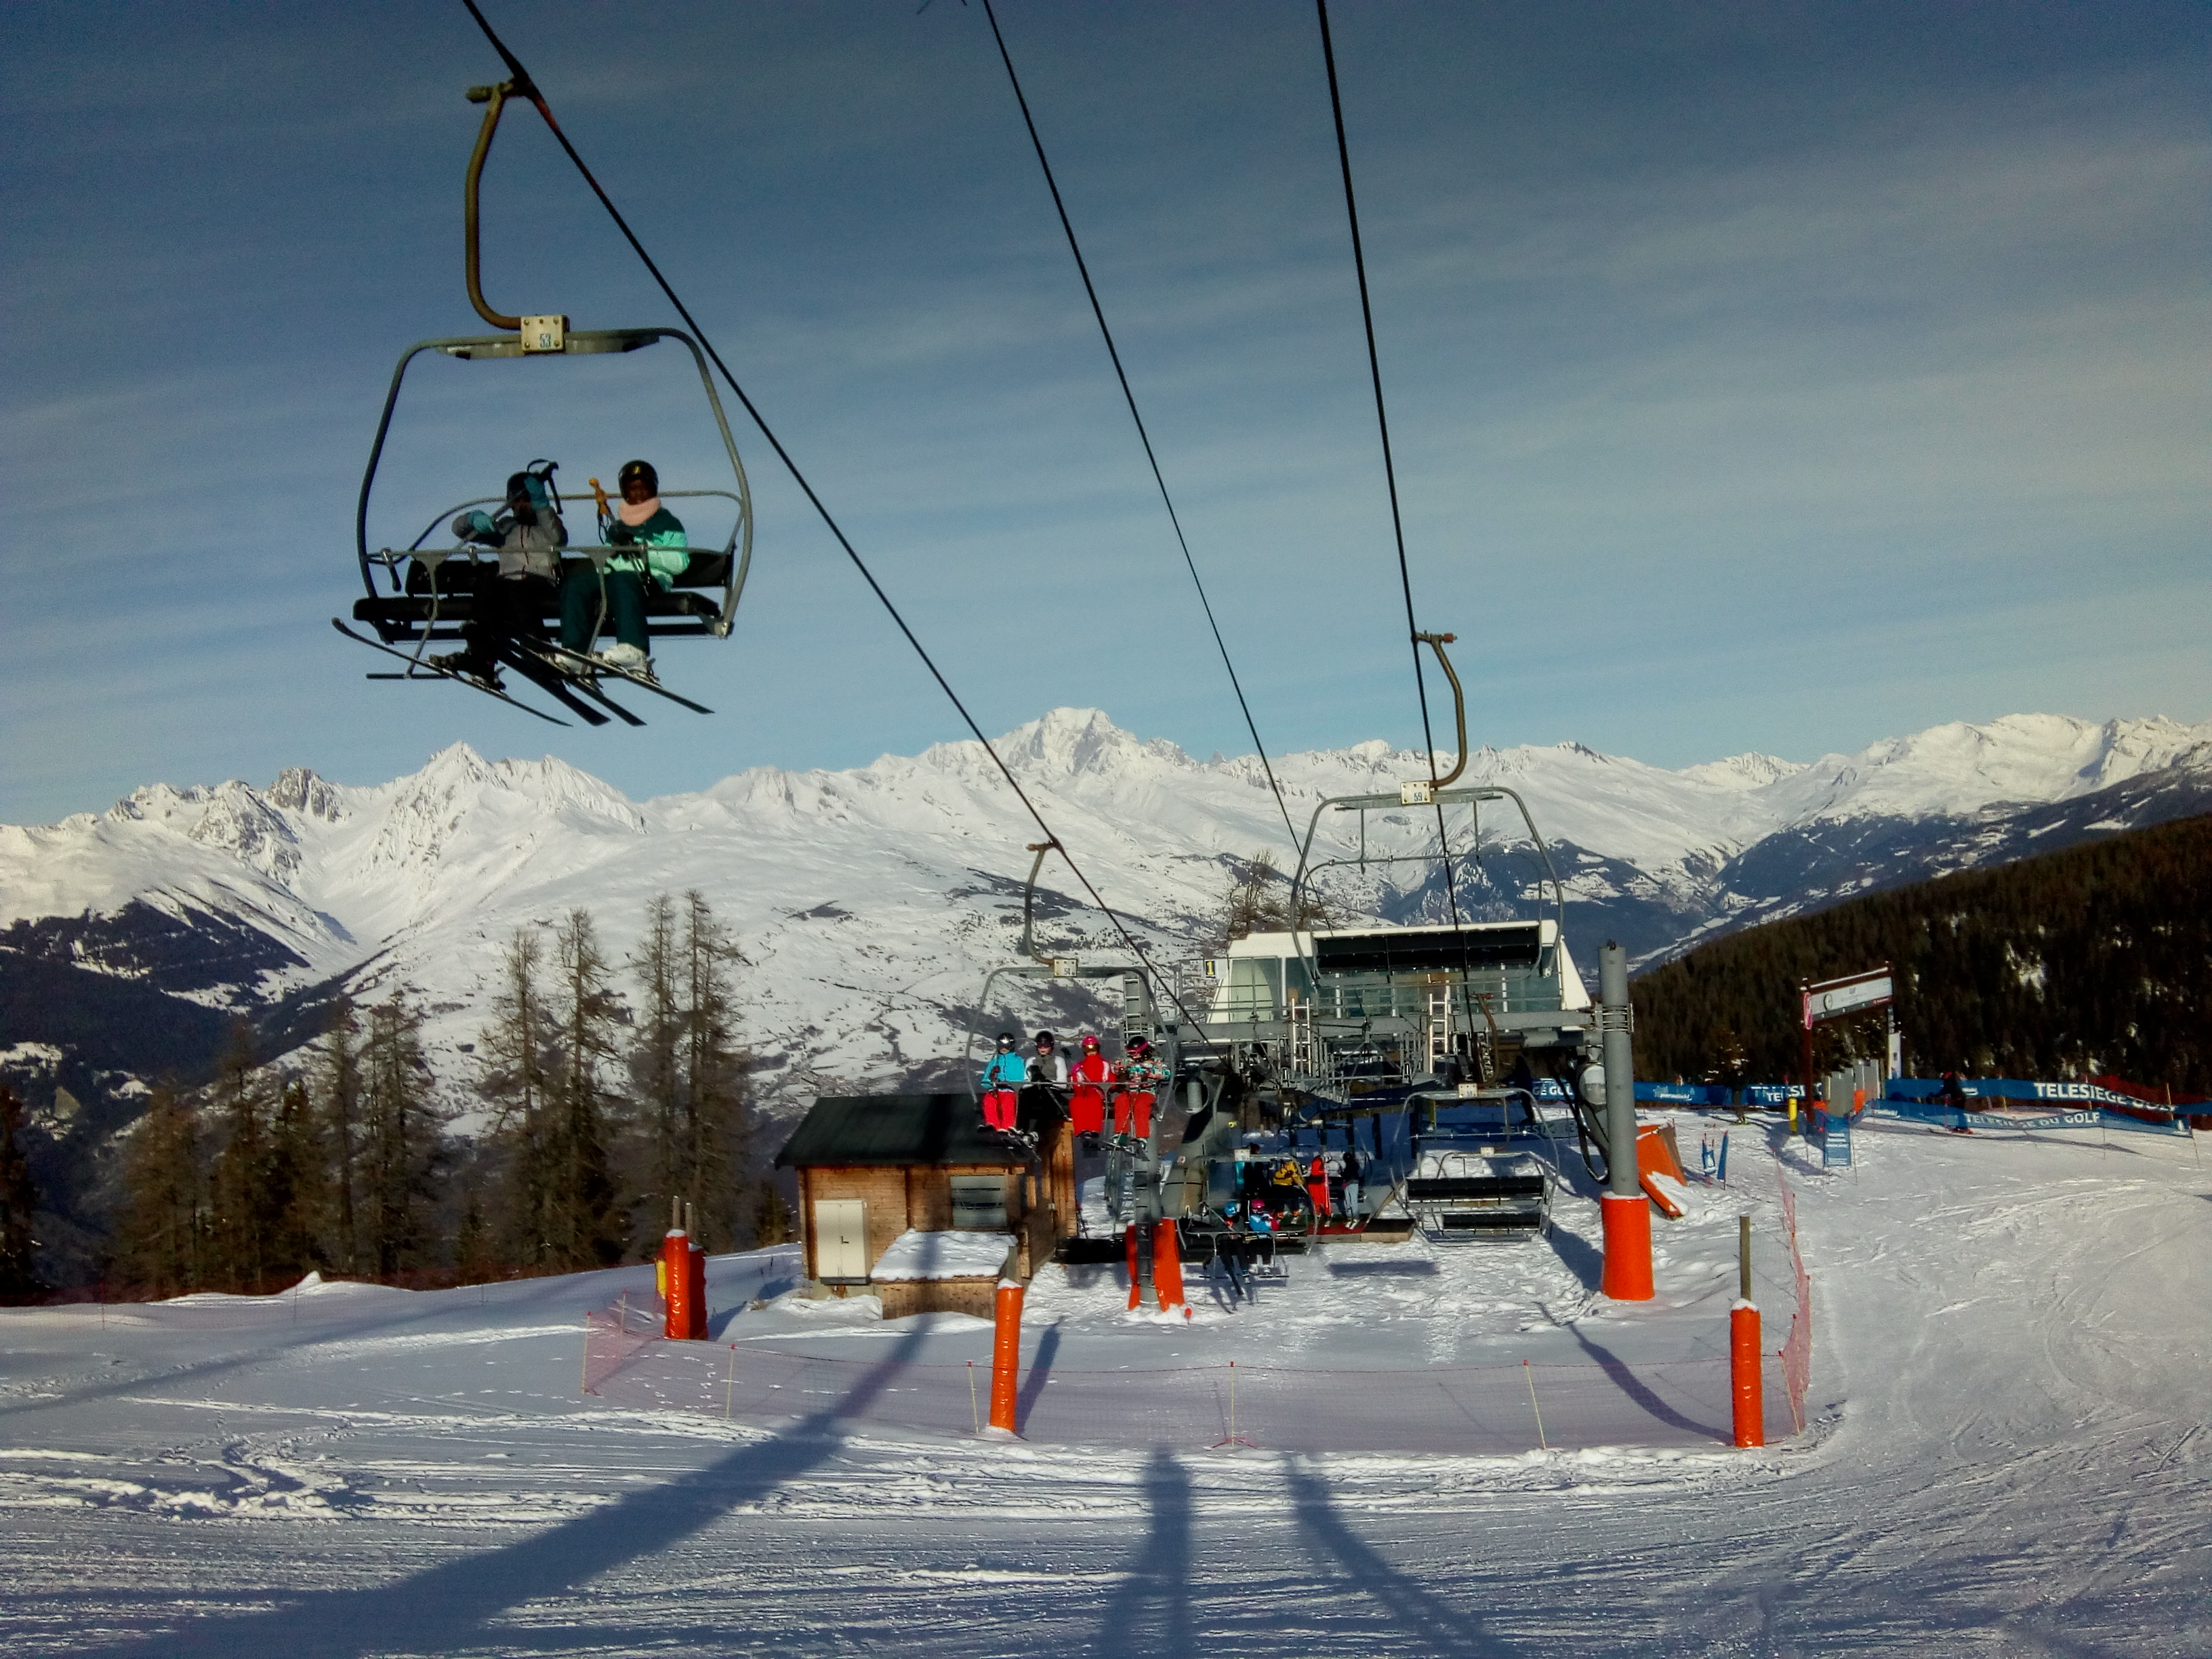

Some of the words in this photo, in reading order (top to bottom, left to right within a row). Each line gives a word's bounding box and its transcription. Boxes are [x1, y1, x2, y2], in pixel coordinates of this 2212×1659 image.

[1206, 961, 1214, 975] 1
[2034, 1083, 2128, 1105] TELESIEGE
[2064, 1112, 2100, 1124] GOLF
